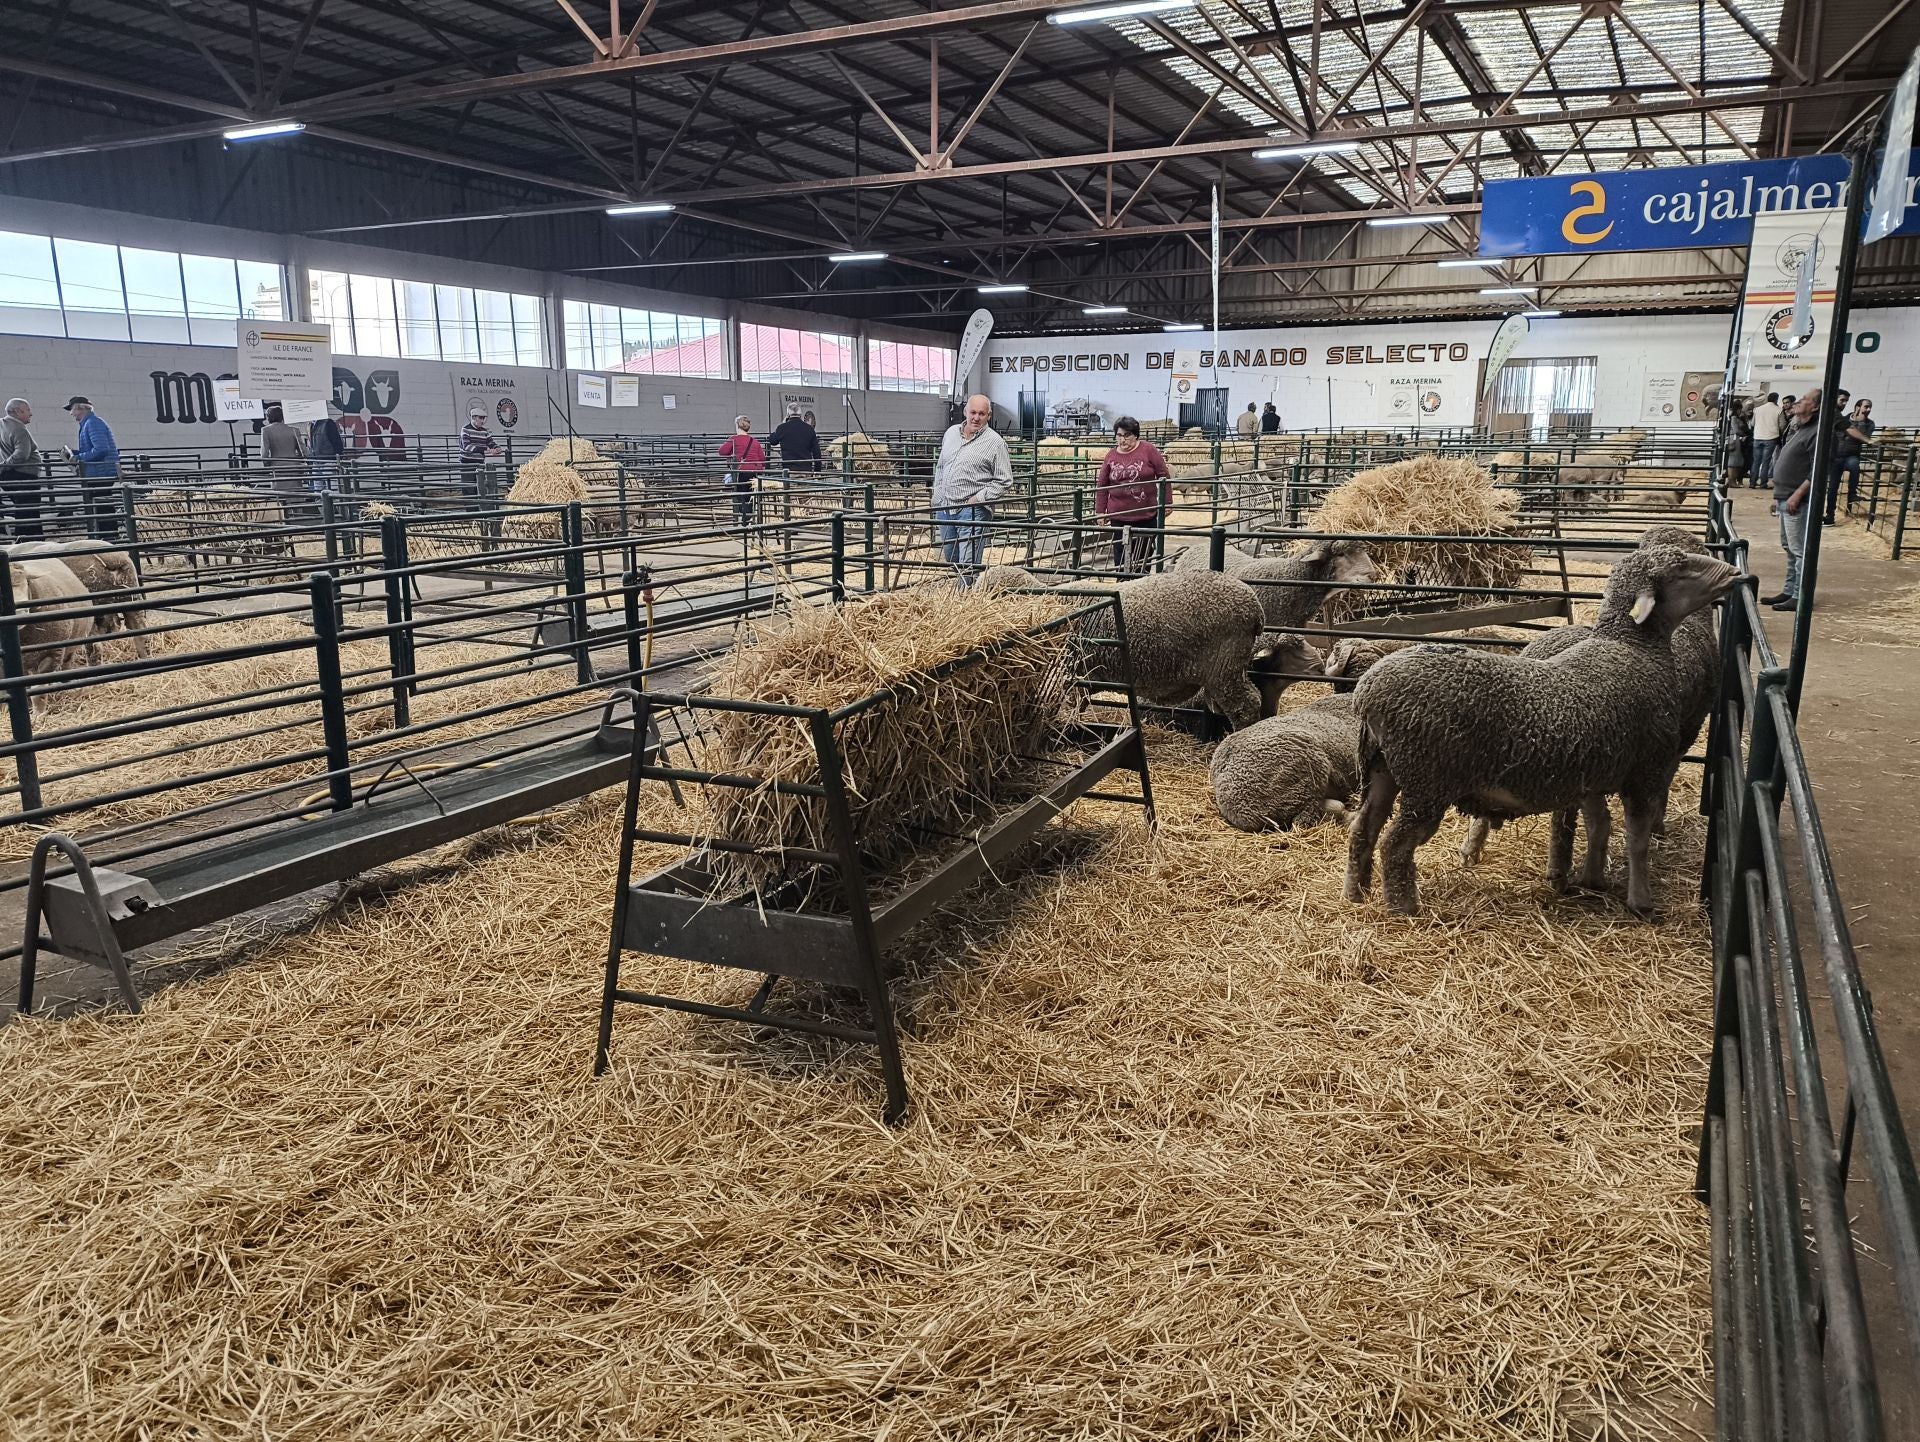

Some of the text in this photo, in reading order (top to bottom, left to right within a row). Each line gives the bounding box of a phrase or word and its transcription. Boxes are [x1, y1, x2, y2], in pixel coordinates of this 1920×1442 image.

[291, 345, 313, 353] FRANCE
[989, 353, 1129, 373] EXPOSICION
[1146, 352, 1175, 370] DE
[1199, 348, 1307, 368] GANADO
[1326, 343, 1469, 365] SELECTO
[460, 377, 515, 388] RAZA MERINA
[584, 391, 601, 401] VENTA
[224, 400, 254, 411] VENTA
